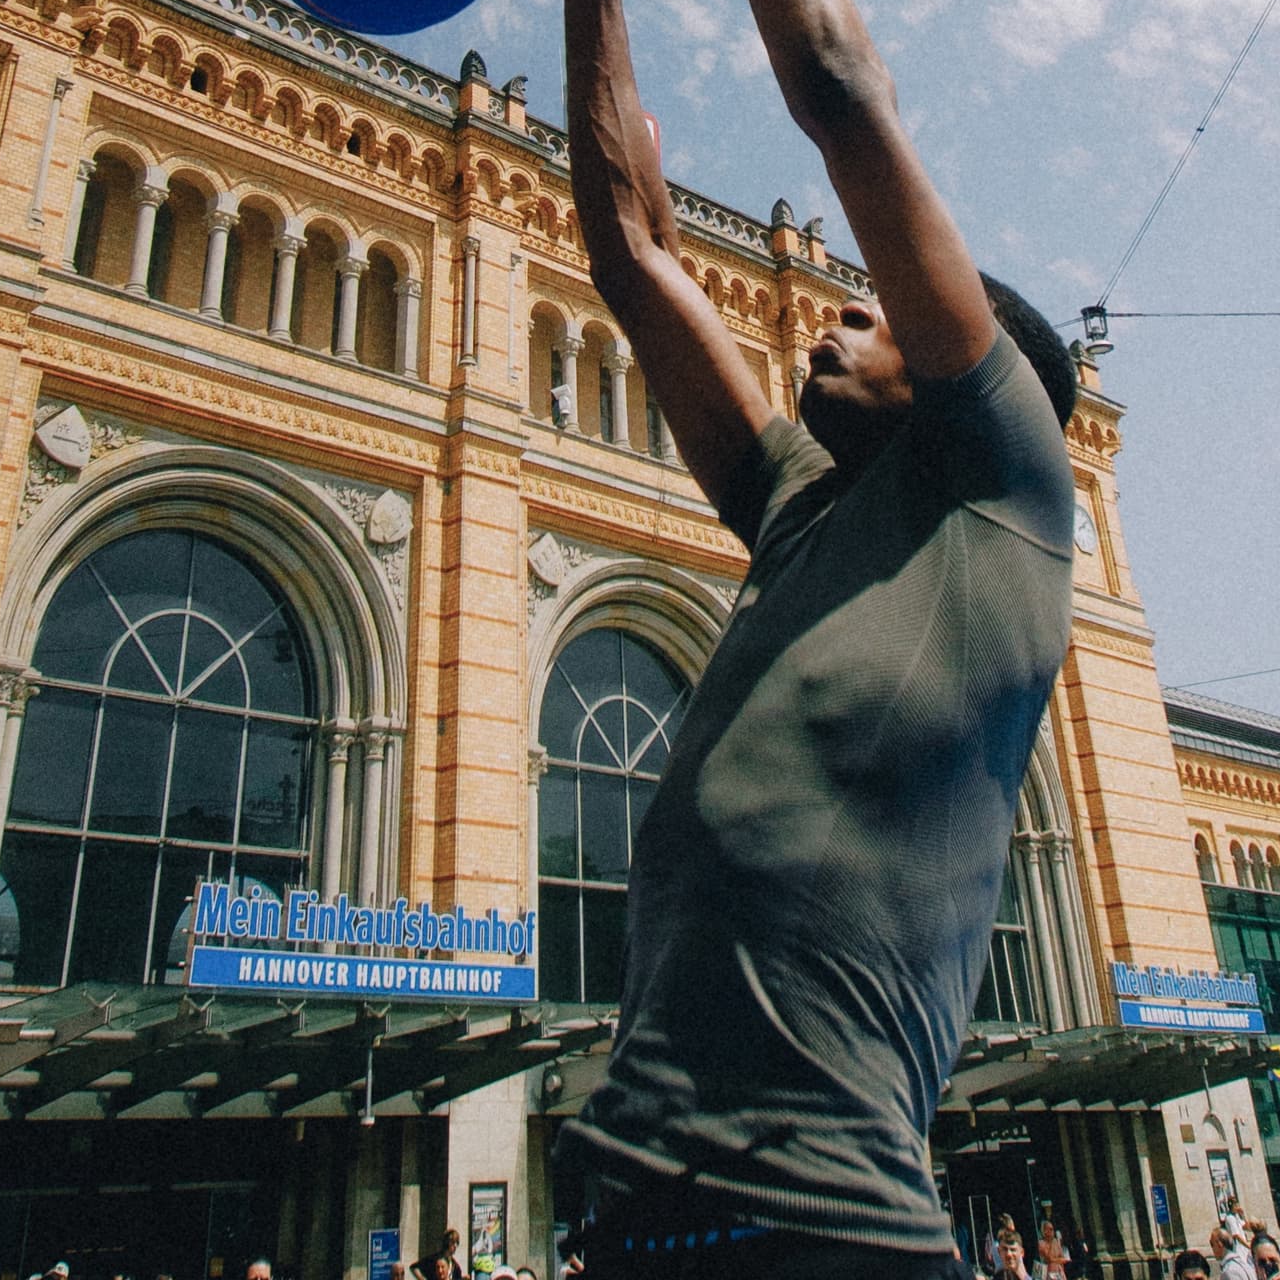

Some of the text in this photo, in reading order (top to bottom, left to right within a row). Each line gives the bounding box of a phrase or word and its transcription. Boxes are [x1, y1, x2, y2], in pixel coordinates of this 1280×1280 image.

[194, 882, 536, 957] Mein Einkaufsbahnhof
[238, 956, 503, 993] HANNOVER HAUPTBAHNHOF
[1113, 961, 1260, 1007] Mein Einkaufsbahnhof
[1139, 1006, 1187, 1026] HANNOVER
